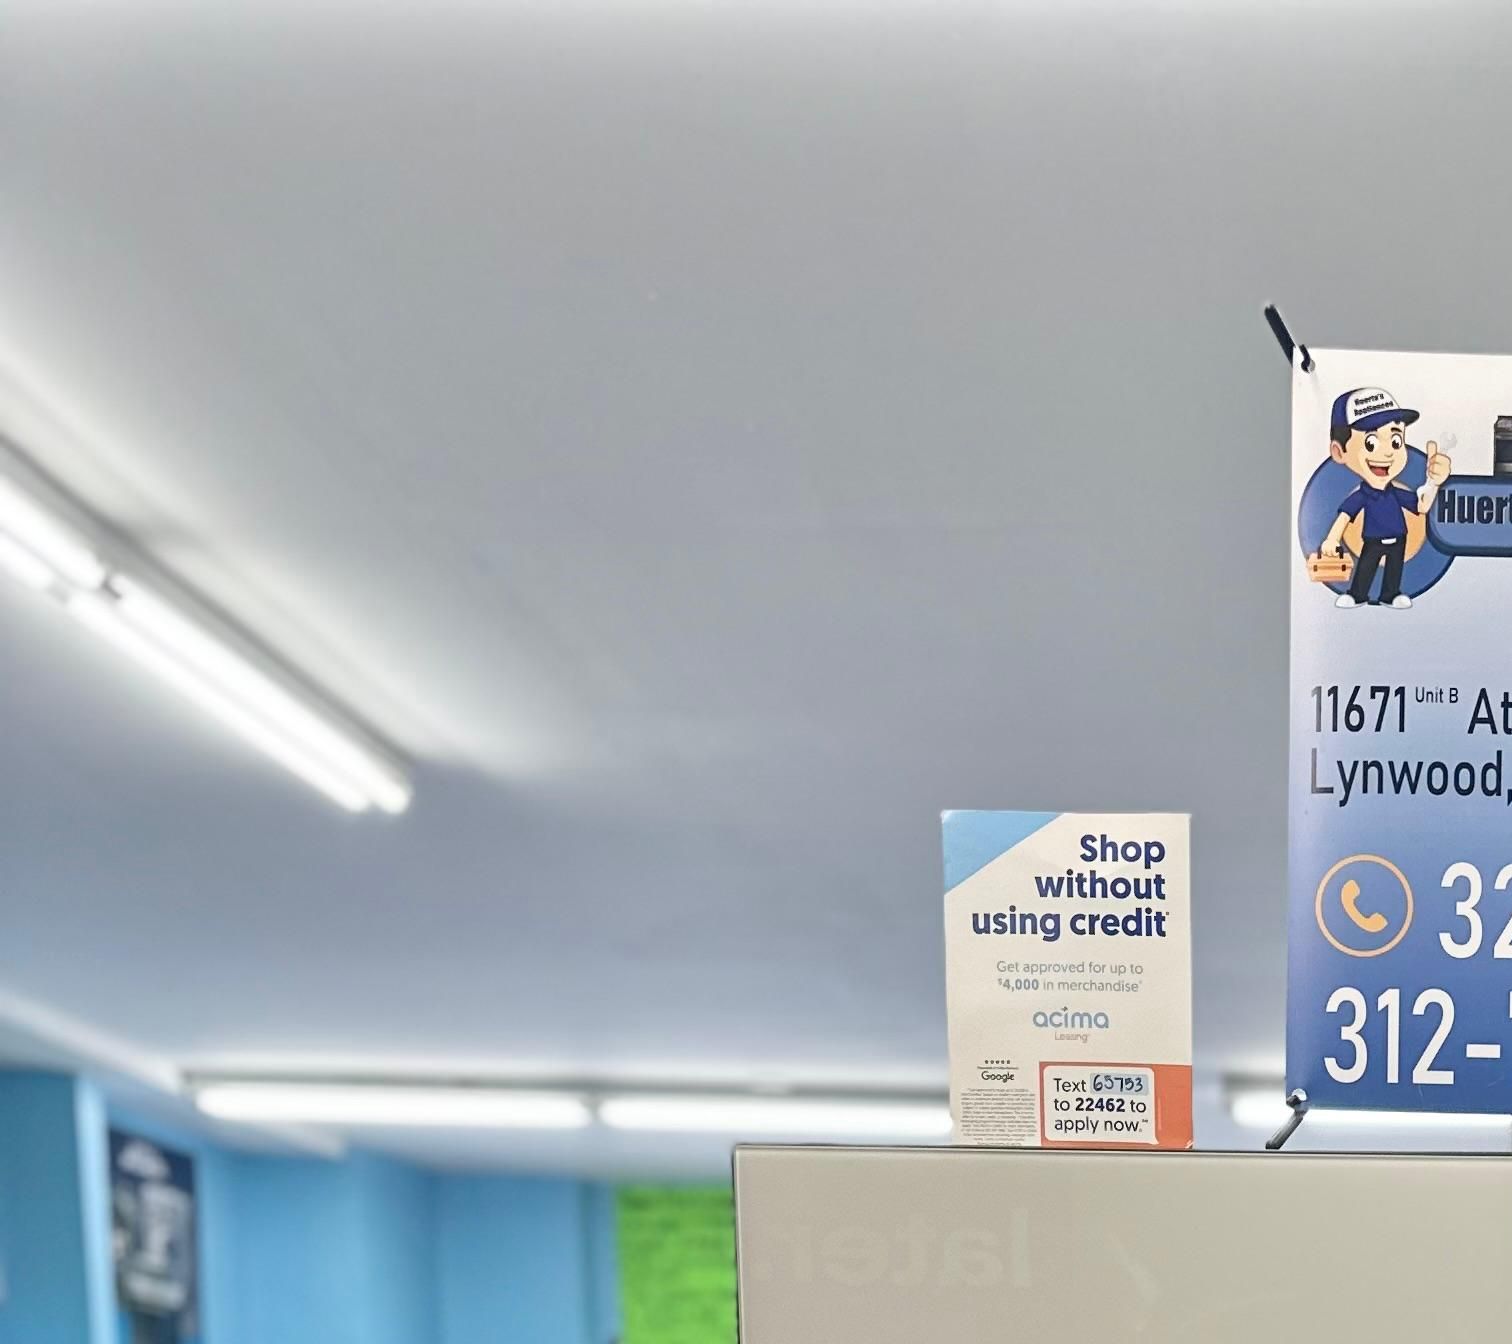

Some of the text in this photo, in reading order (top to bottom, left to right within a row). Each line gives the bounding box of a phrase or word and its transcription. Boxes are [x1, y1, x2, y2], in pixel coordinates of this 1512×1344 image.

[1310, 685, 1406, 734] 11671
[1415, 687, 1444, 704] Unit
[1448, 687, 1459, 704] B
[1080, 834, 1166, 870] Shop
[1034, 868, 1166, 901] without
[972, 905, 1061, 943] using
[996, 961, 1143, 976] Get approved for up to
[1043, 980, 1054, 990] in
[1032, 1006, 1109, 1029] acima
[981, 1070, 1015, 1083] Google
[1053, 1078, 1087, 1092] Text
[1053, 1097, 1147, 1113] to 22462 to
[1054, 1116, 1099, 1134] apply
